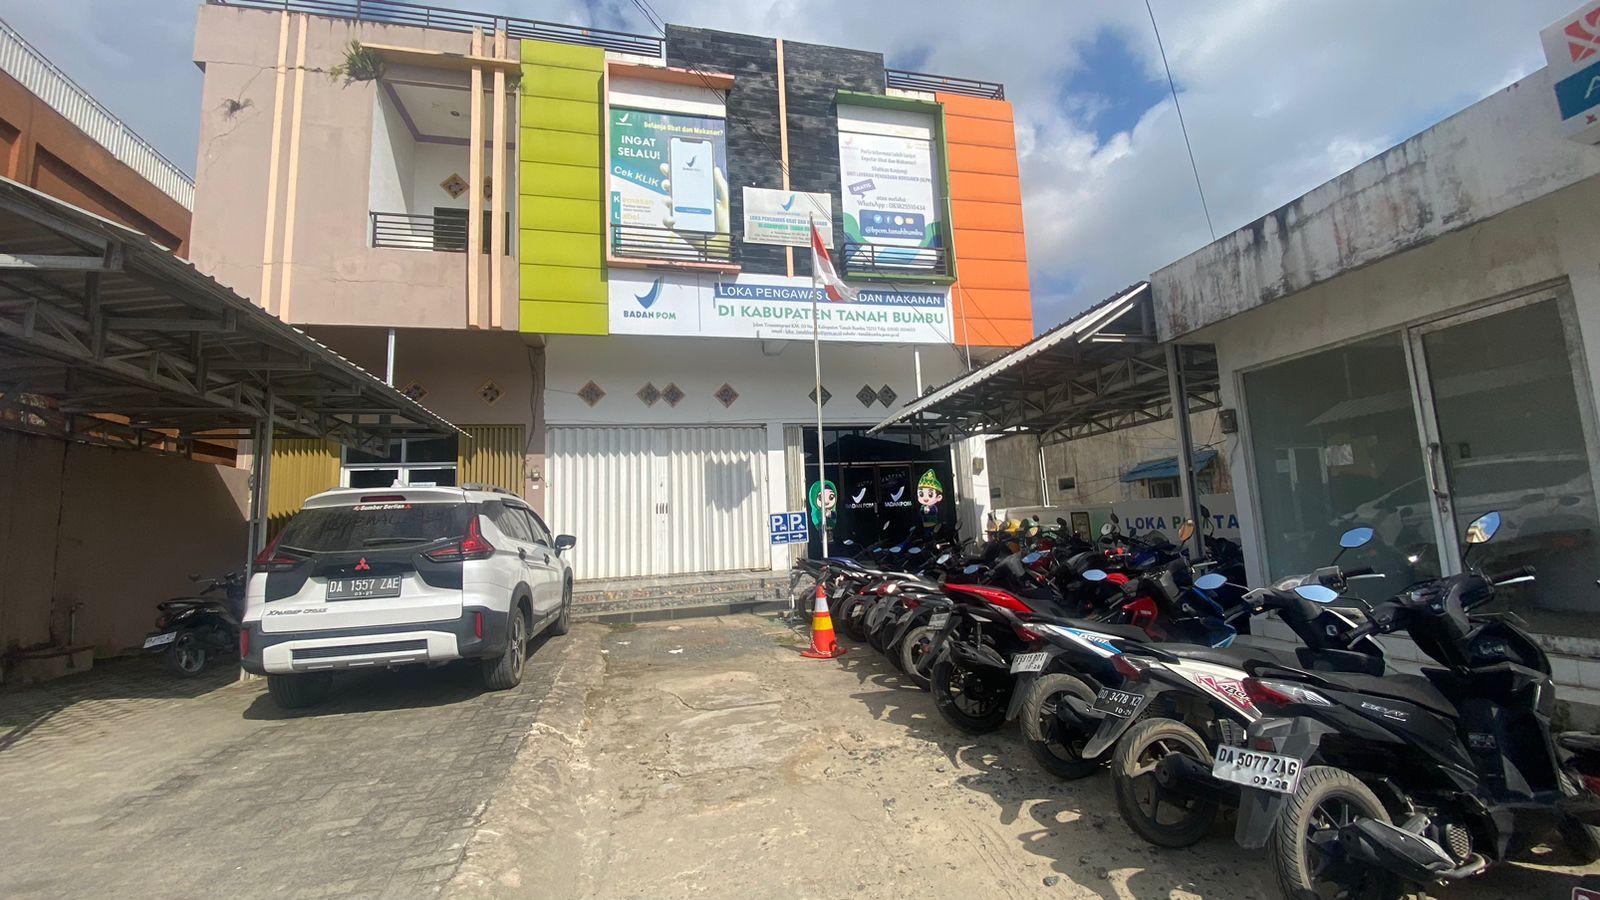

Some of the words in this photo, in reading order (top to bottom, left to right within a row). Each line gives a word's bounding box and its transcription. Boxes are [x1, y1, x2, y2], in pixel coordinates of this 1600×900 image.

[621, 135, 656, 147] INGAT
[618, 146, 660, 160] SELALU!
[614, 166, 634, 178] Cek
[635, 172, 658, 186] KLIK
[720, 286, 752, 296] LOKA
[756, 288, 823, 300] PENGAWAS
[860, 293, 882, 302] DAN
[886, 295, 940, 304] MAKANAN
[624, 310, 654, 319] BADAN
[656, 312, 676, 320] POM
[718, 305, 734, 316] DI
[741, 306, 831, 320] KABUPATEN
[836, 310, 888, 322] TANAH
[893, 312, 944, 324] BUMBU
[771, 516, 783, 532] P
[790, 514, 802, 530] P
[1126, 517, 1166, 530] LOKA
[330, 581, 343, 592] DA
[351, 579, 375, 591] 1557
[380, 578, 399, 589] ZAE
[1109, 692, 1129, 704] 3478
[1219, 748, 1234, 764] DA
[1237, 752, 1270, 771] 5077
[1271, 758, 1297, 775] ZAG
